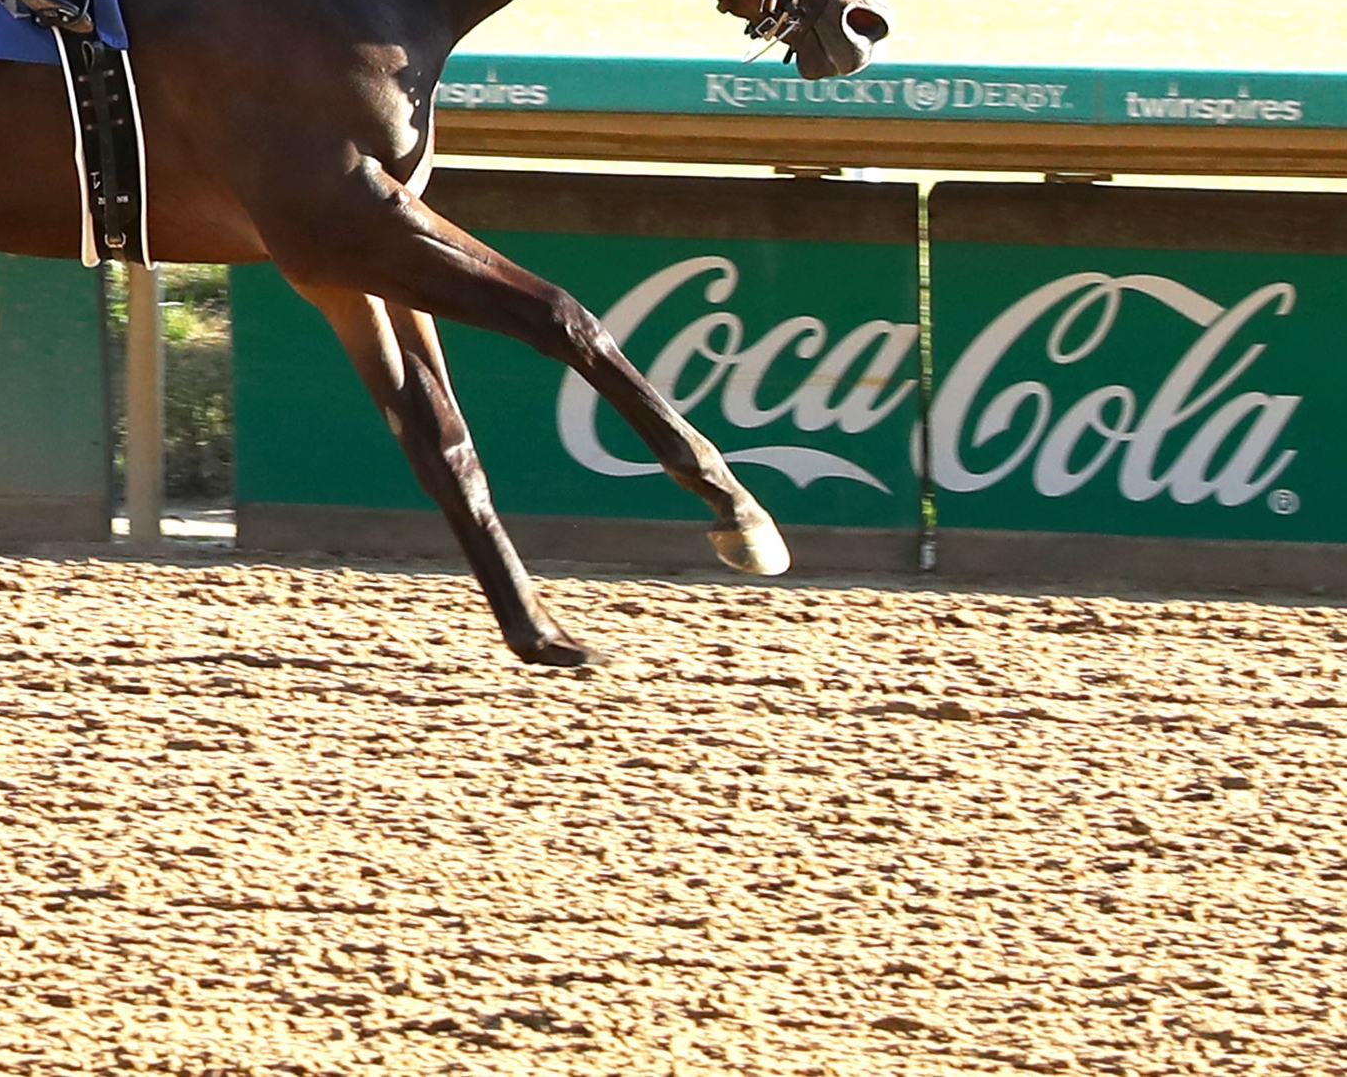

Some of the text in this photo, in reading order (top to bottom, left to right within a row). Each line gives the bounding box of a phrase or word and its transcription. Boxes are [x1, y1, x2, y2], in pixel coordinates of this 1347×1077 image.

[702, 73, 1069, 113] KENTUCKY DERBY
[1127, 80, 1303, 126] twinspires
[556, 255, 1302, 506] Coca Cola
